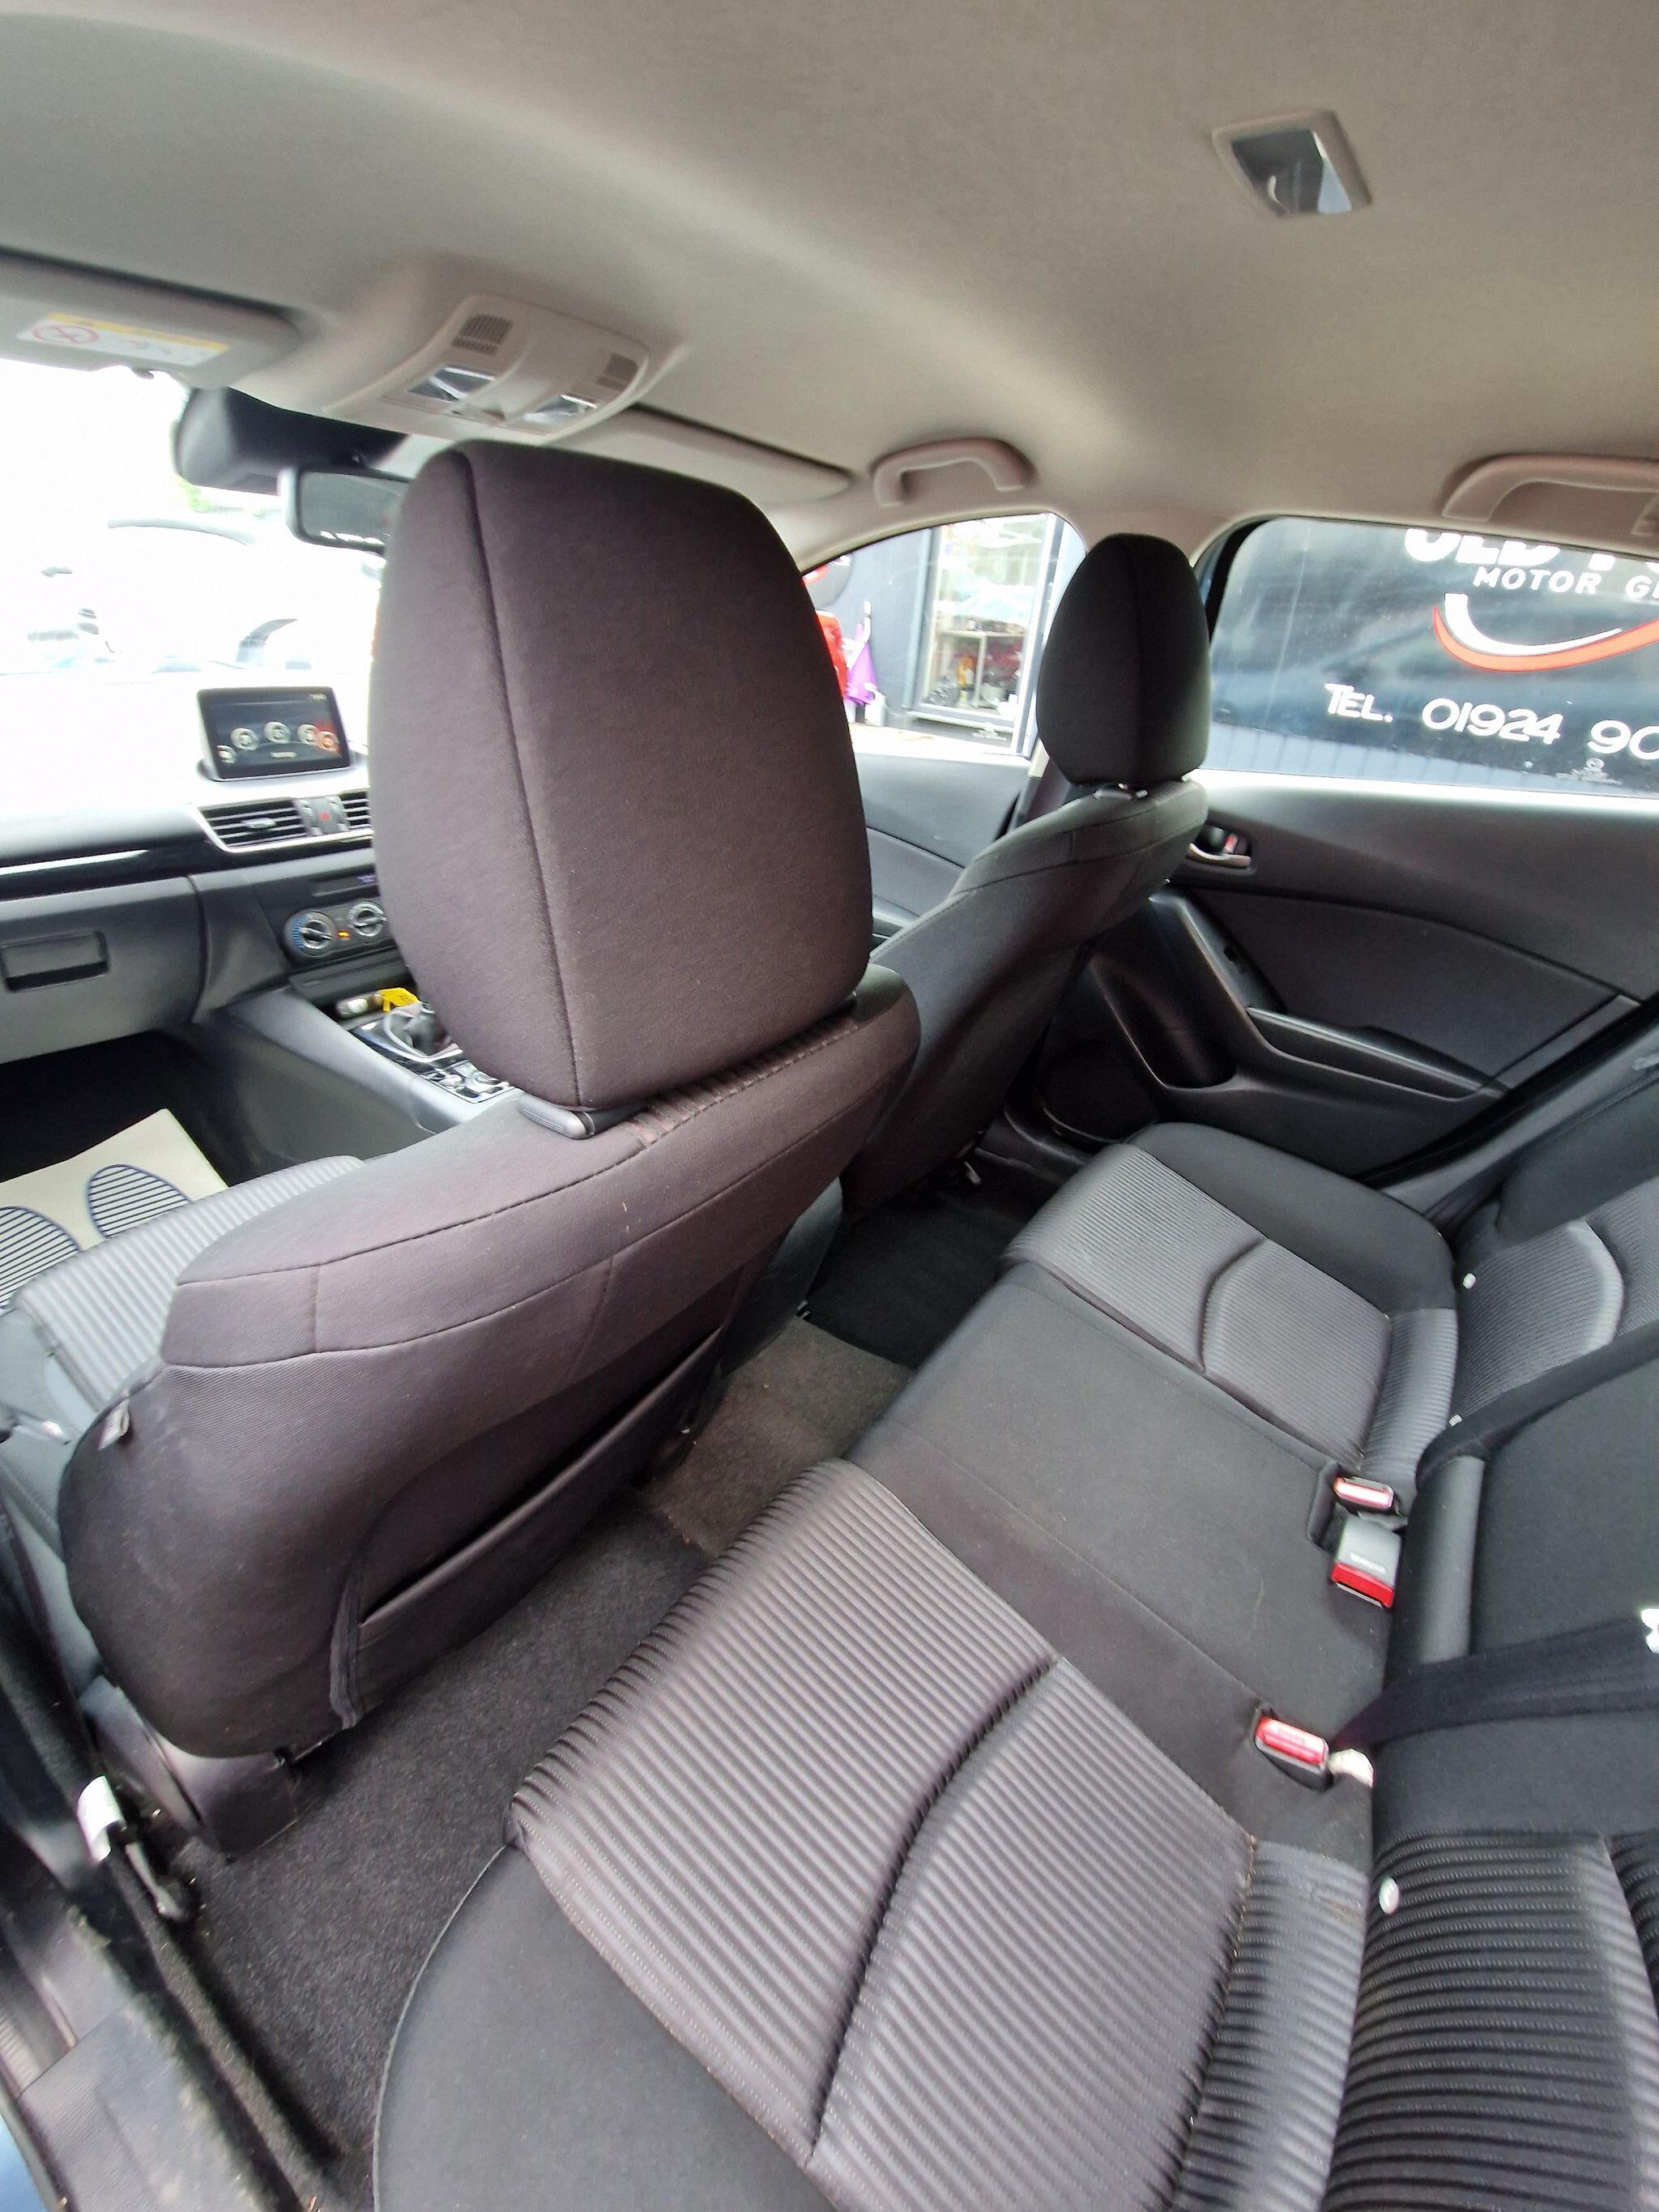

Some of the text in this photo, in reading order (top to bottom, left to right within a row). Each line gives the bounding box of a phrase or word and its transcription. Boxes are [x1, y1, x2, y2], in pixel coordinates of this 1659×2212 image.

[1473, 566, 1602, 595] MOTOR
[1324, 682, 1659, 760] TEL. 01924 90
